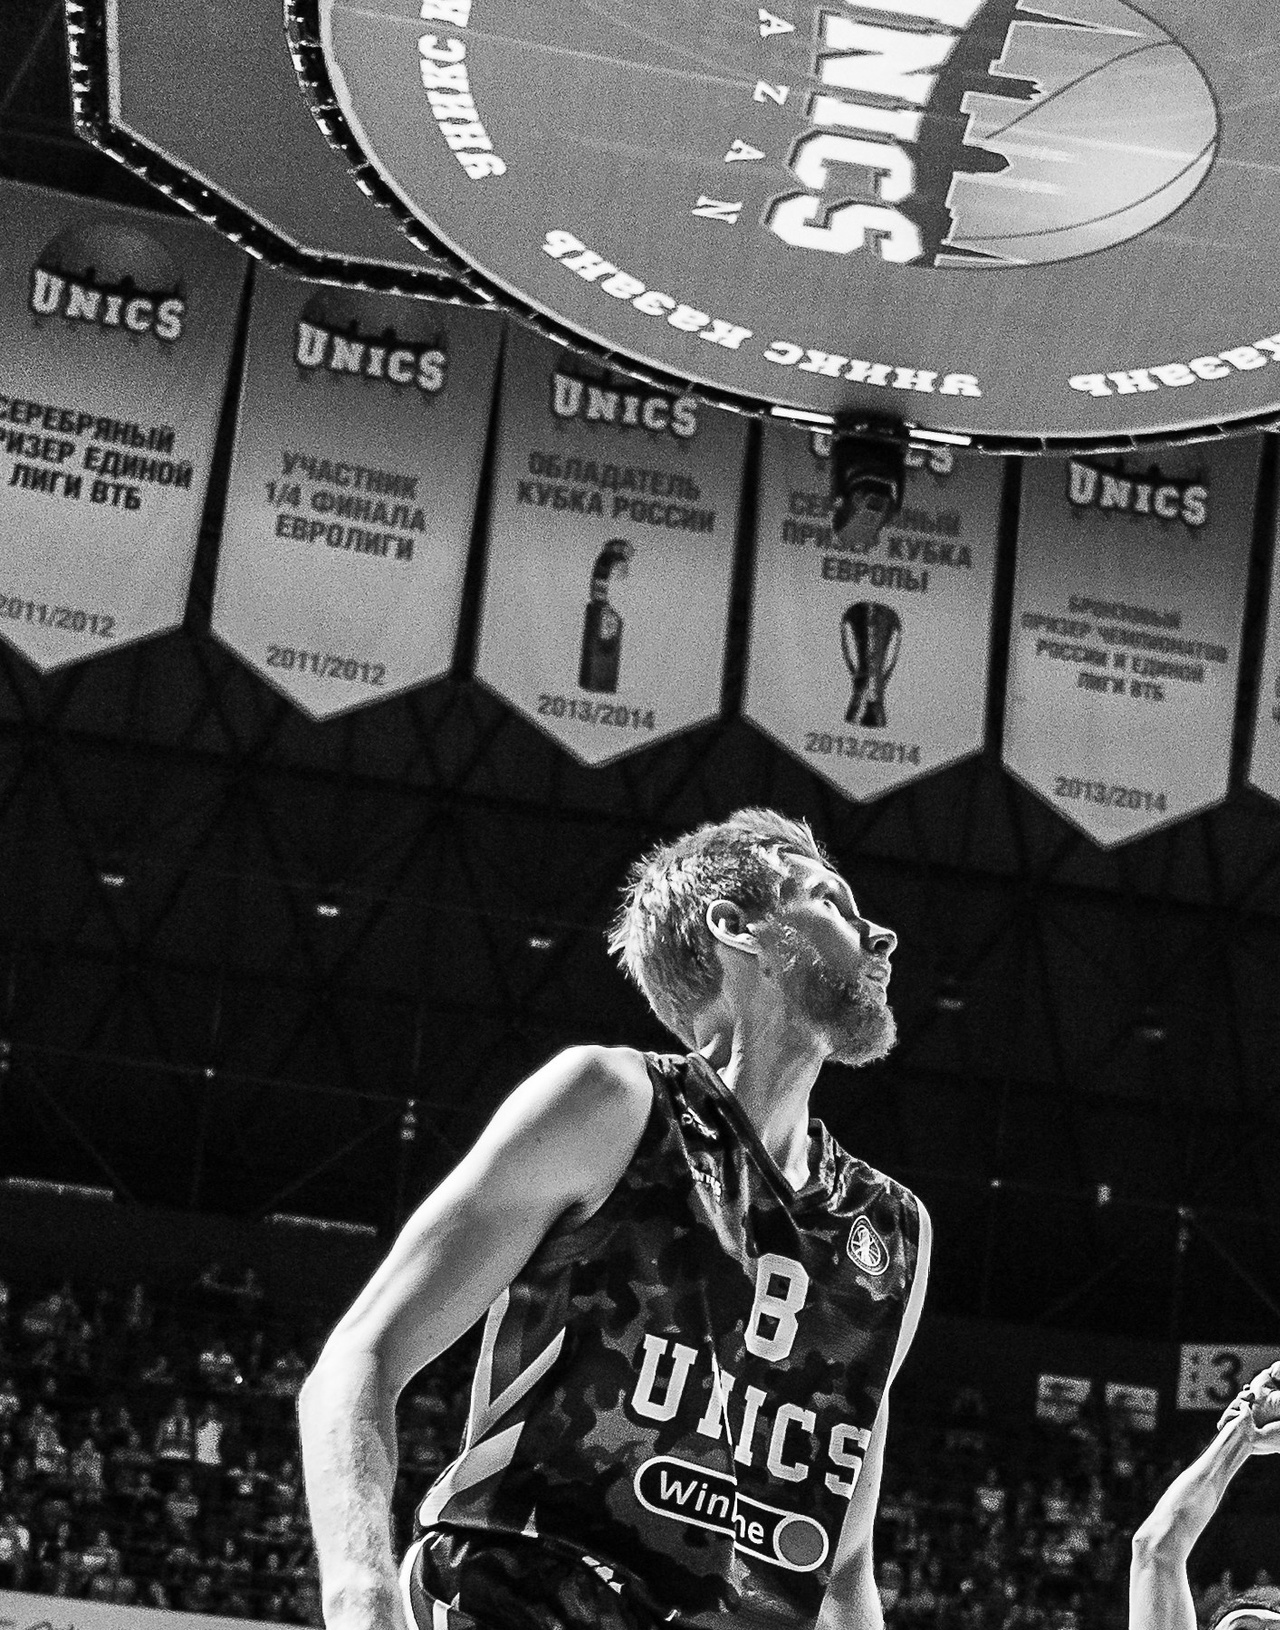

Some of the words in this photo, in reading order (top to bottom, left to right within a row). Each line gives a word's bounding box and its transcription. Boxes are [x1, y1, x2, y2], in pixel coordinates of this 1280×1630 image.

[692, 8, 795, 224] AZAN
[769, 0, 985, 263] NICS
[31, 268, 185, 340] UNICS
[297, 321, 446, 392] UNICS
[763, 341, 982, 397] УНИКС
[552, 372, 698, 437] UNICS
[0, 430, 75, 464] ИЗЕР
[84, 442, 194, 490] ЕДИНОЙ
[8, 464, 82, 500] ЛИГИ
[90, 480, 142, 510] ВТБ
[281, 450, 420, 500] УЧАСТНИК
[528, 451, 700, 502] ОБЛАДАТЕЛЬ
[310, 489, 427, 532] ФИНАЛА
[517, 479, 604, 517] КУБКА
[611, 498, 715, 534] РОССИИ
[1069, 461, 1207, 527] UNICS
[275, 514, 414, 561] ЕВРОЛИГИ
[821, 556, 928, 594] ЕВРОПЫ
[266, 645, 388, 684] 2011/2012
[537, 694, 656, 732] 2013/2014
[744, 1254, 809, 1362] 8
